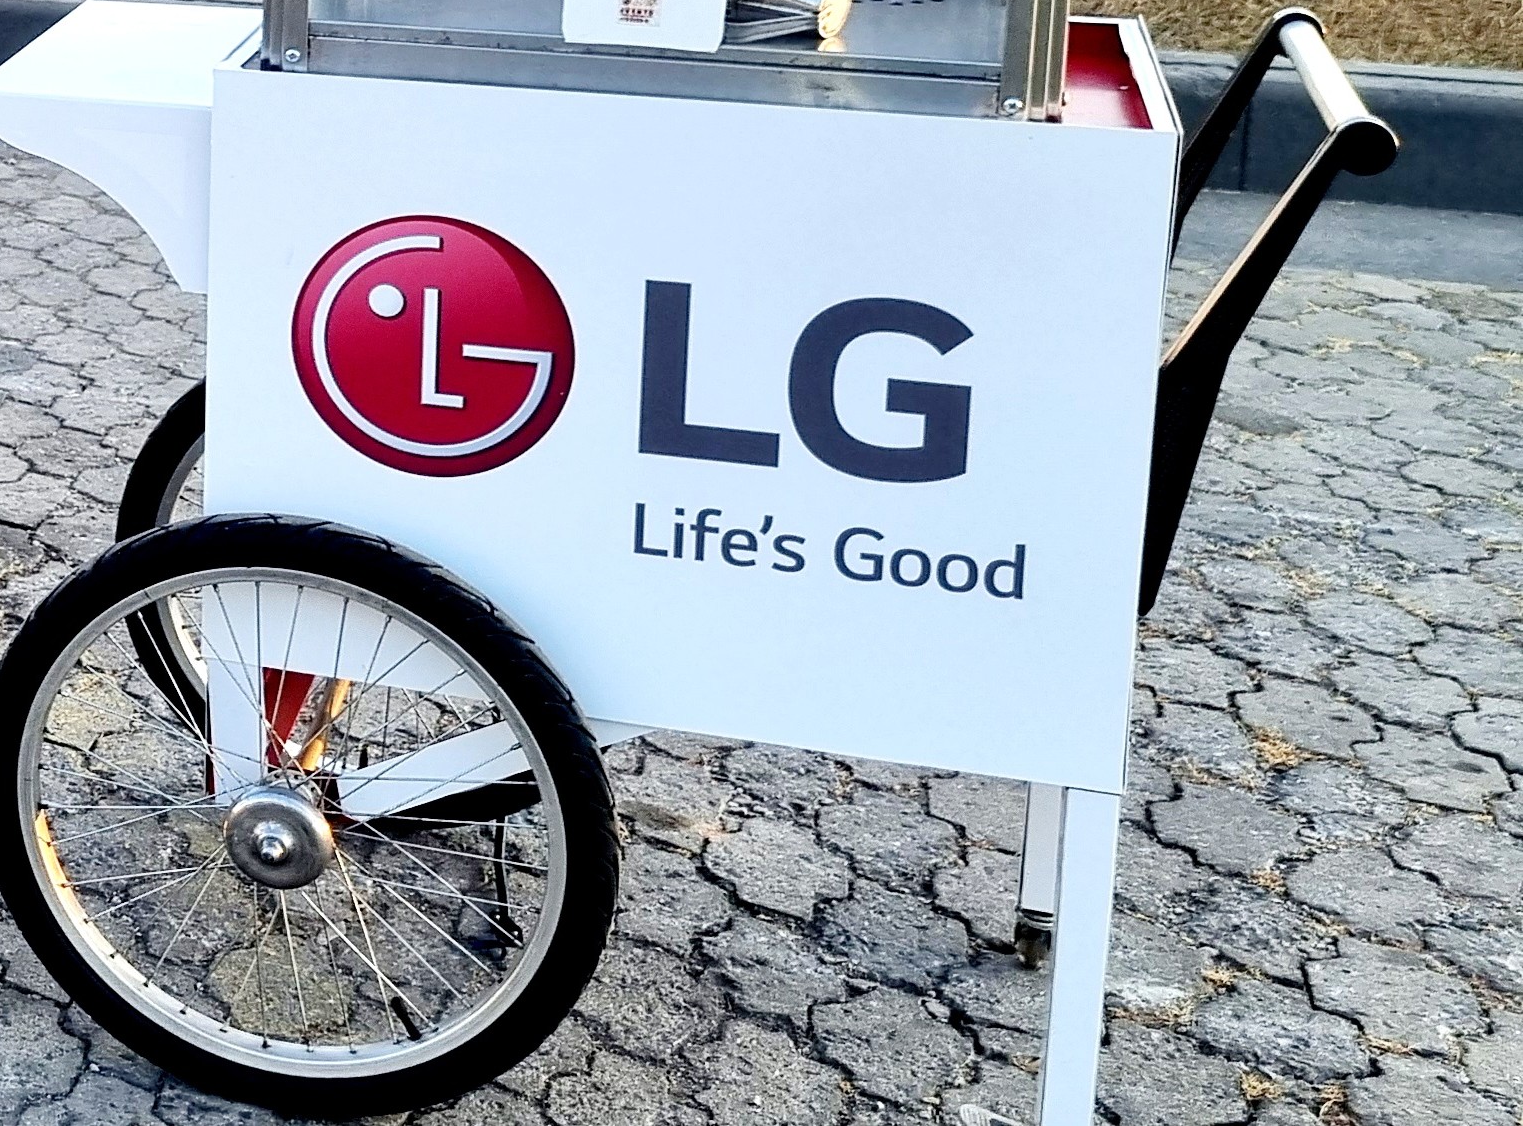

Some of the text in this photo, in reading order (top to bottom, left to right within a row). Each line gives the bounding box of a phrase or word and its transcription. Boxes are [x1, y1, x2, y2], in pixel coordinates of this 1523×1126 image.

[638, 279, 974, 483] LG
[633, 503, 1027, 599] Life's Good
